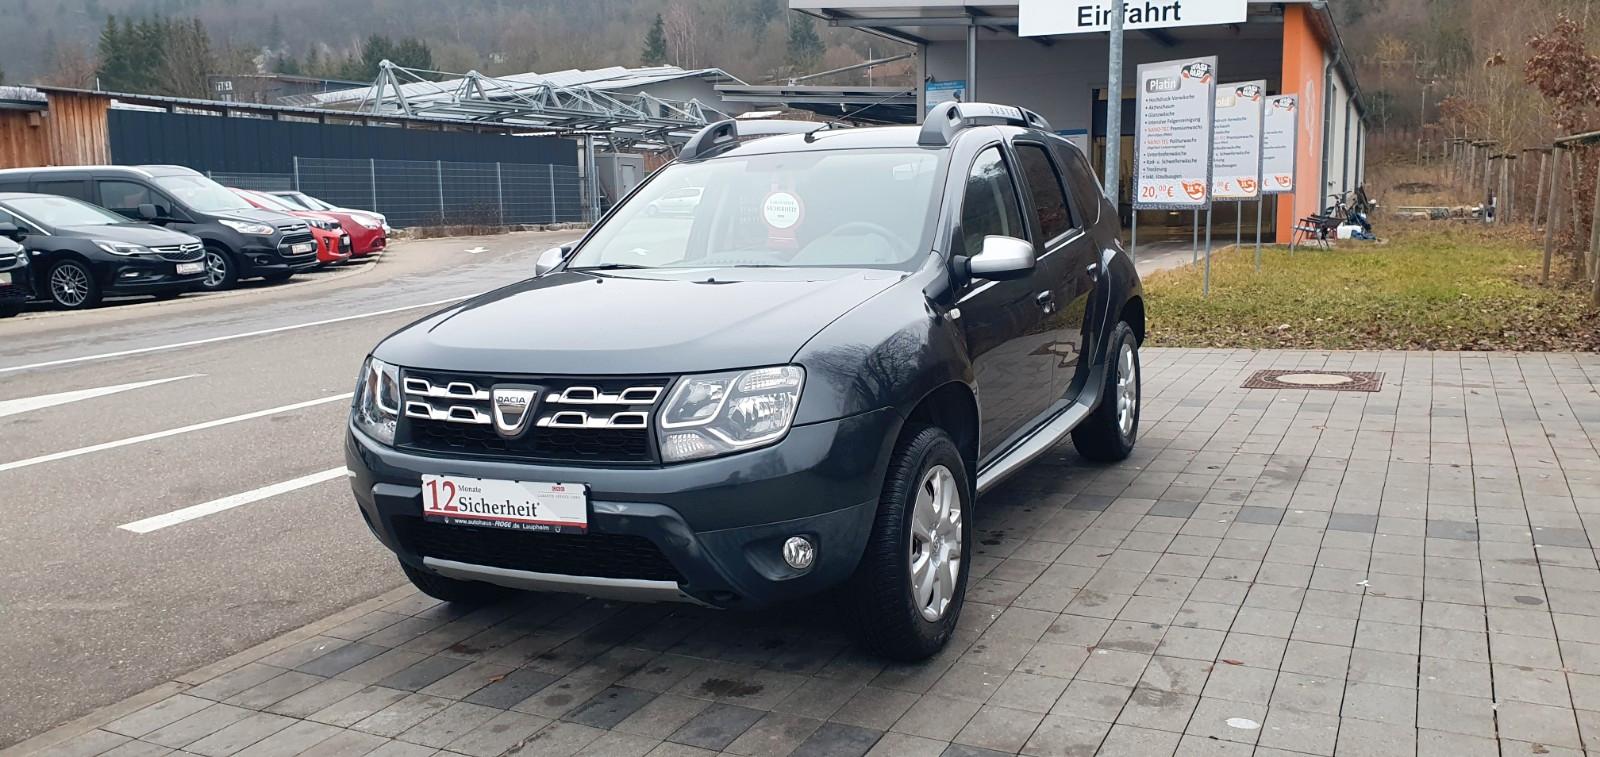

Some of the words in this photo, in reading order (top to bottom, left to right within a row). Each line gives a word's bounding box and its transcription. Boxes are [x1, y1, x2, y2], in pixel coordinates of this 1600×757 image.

[1150, 79, 1176, 91] Platin
[426, 480, 458, 512] 12
[458, 485, 482, 493] Monate
